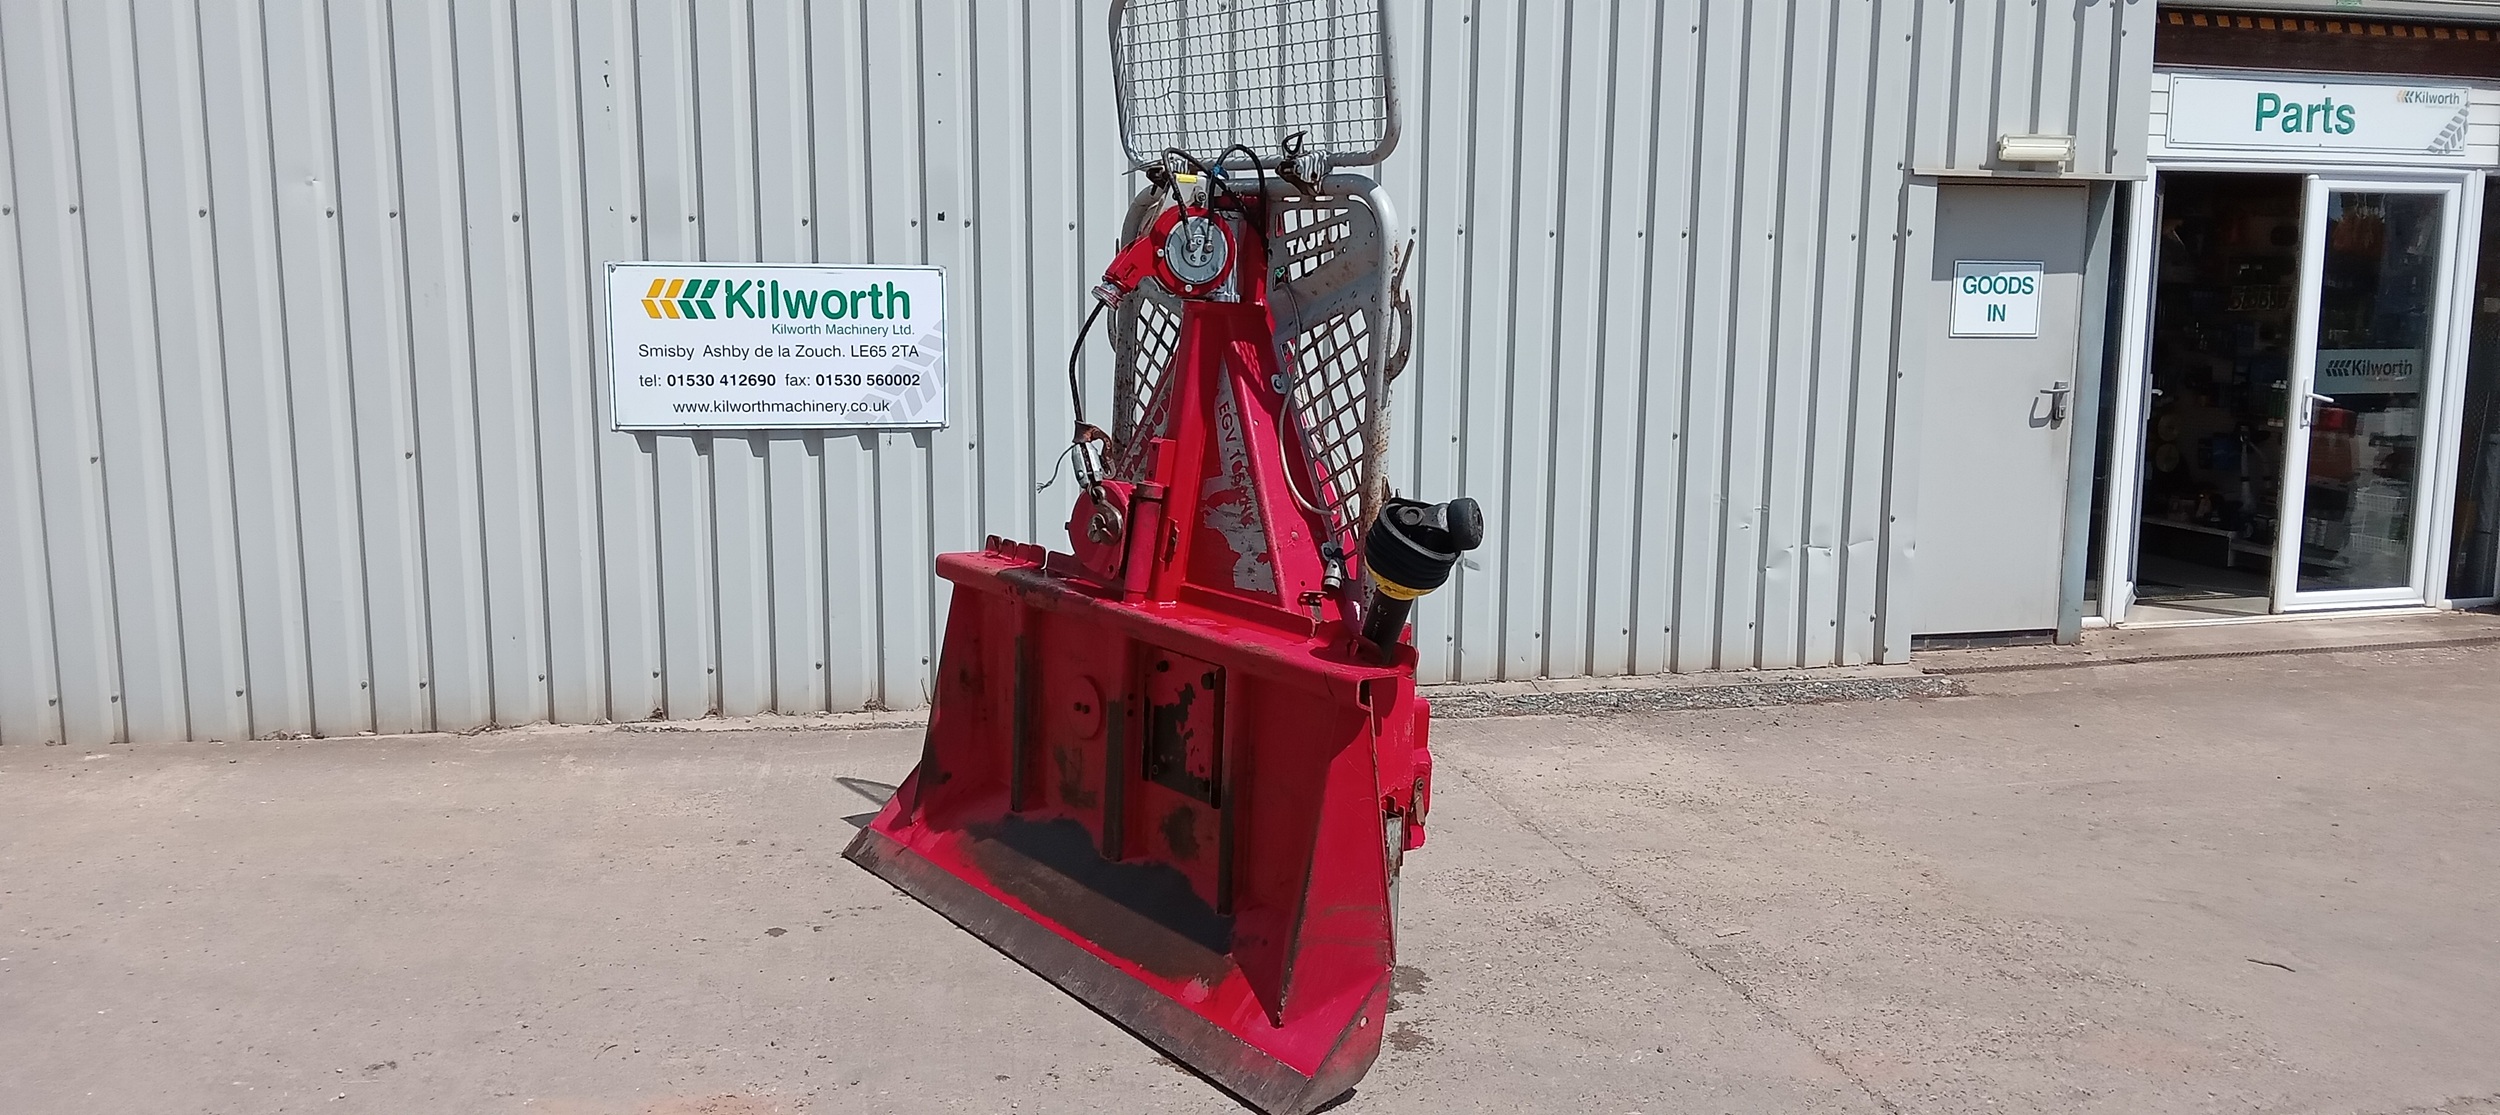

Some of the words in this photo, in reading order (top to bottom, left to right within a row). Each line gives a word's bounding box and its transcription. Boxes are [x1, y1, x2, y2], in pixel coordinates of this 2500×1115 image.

[2414, 91, 2460, 104] Kilworth
[2255, 92, 2355, 135] Parts
[1286, 220, 1351, 256] TAJFUN
[1963, 276, 2034, 295] GOODS
[725, 280, 910, 319] Kilworth
[1987, 304, 2006, 322] IN
[772, 324, 821, 334] Kilworth
[826, 324, 888, 337] Machinery
[893, 325, 914, 334] Ltd.
[639, 344, 694, 360] Smisby
[703, 345, 749, 360] Ashby
[755, 345, 773, 357] de
[779, 345, 790, 357] la
[796, 345, 845, 357] Zouch.
[851, 345, 886, 357] LE65
[892, 345, 919, 357] 2TA
[2352, 360, 2413, 376] Kilworth
[640, 375, 661, 386] tel:
[667, 375, 714, 386] 01530
[720, 374, 775, 386] 412690
[785, 374, 810, 386] fax:
[816, 374, 861, 386] 01530
[867, 374, 920, 386] 560002
[673, 400, 889, 415] www.kilworthmachinery.co.uk
[1218, 401, 1237, 442] EGV
